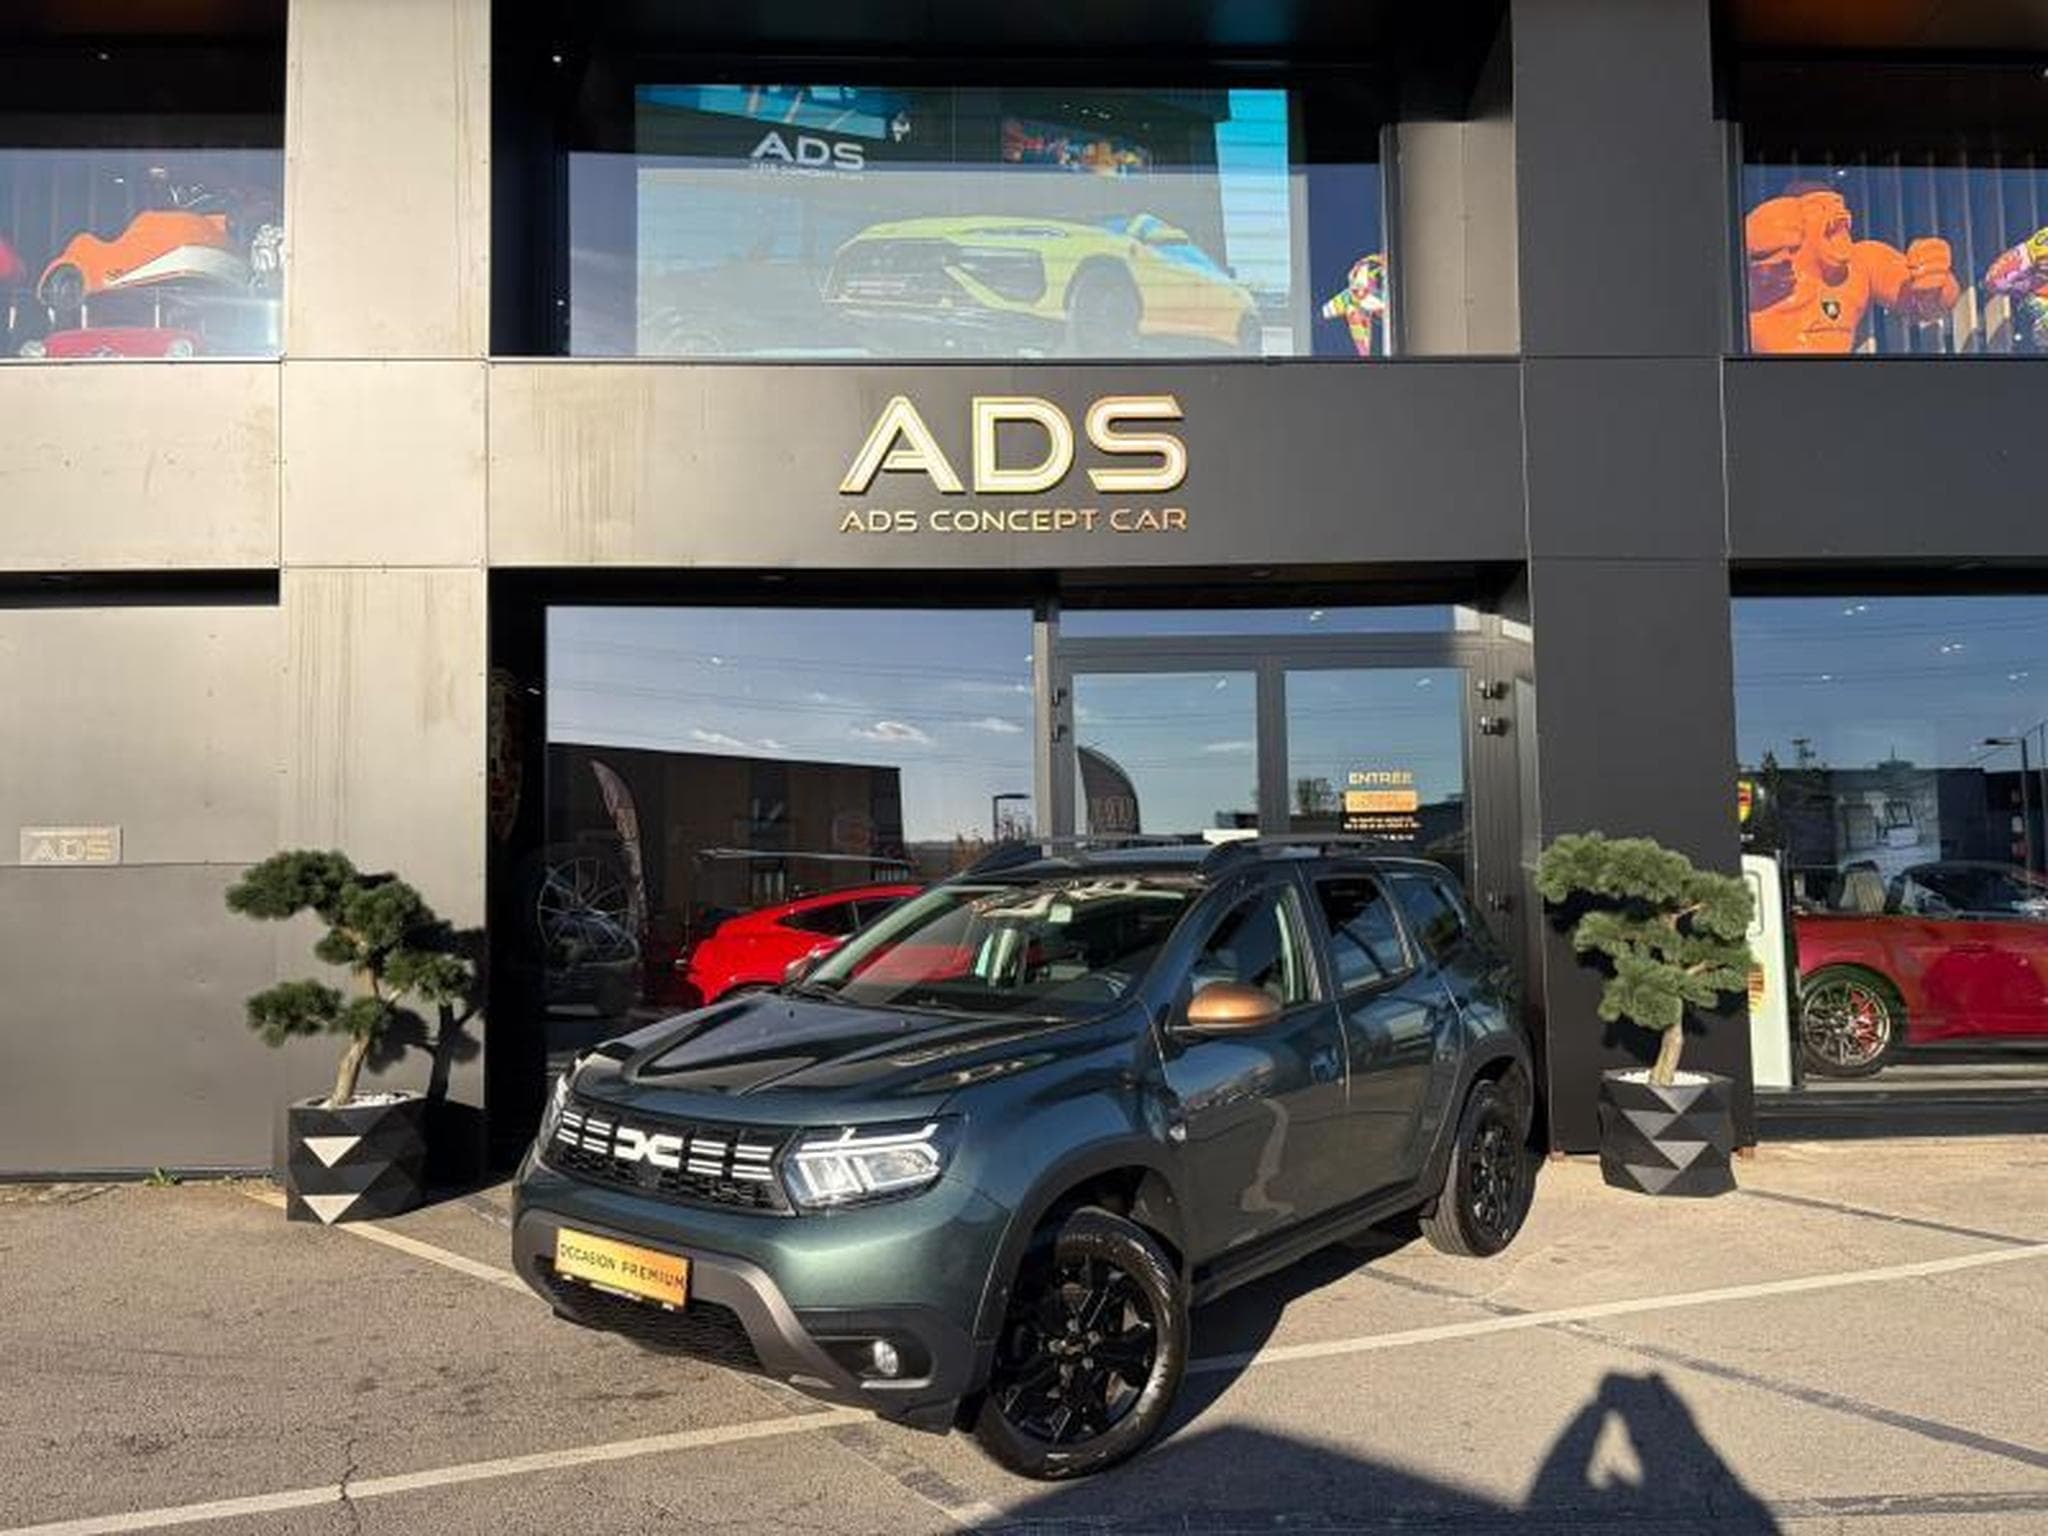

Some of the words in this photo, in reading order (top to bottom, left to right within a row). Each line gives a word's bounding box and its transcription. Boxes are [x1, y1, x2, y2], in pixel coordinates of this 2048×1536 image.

[752, 131, 865, 170] ADS
[839, 395, 1188, 494] ADS
[839, 510, 919, 533] ADS
[930, 510, 1099, 533] CONCEPT
[1110, 508, 1187, 532] CAR
[560, 1243, 616, 1270] OCCASION
[622, 1261, 685, 1290] PREMIUM
